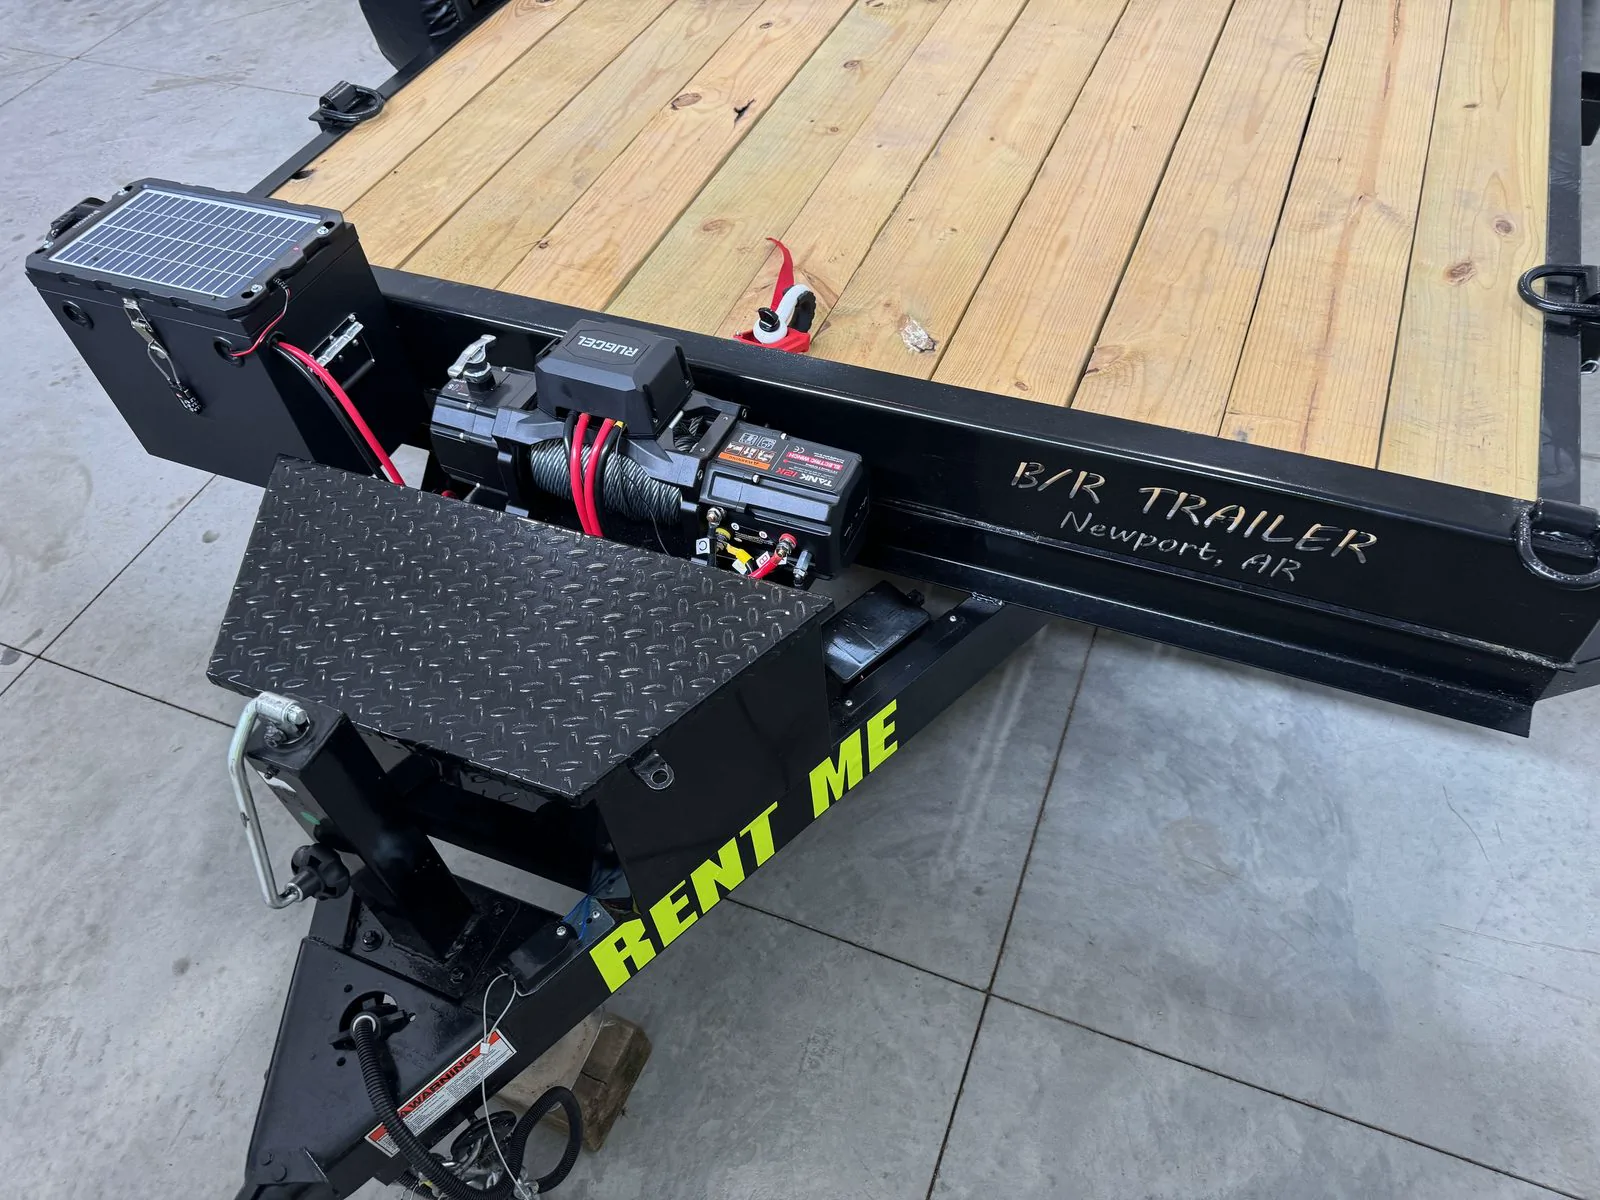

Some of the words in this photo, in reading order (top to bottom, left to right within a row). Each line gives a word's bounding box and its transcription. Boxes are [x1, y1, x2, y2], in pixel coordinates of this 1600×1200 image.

[578, 335, 639, 357] RUGCEL
[788, 452, 810, 463] WINCH
[811, 458, 841, 469] ELECTRIC
[800, 473, 832, 487] TANK
[1011, 461, 1106, 504] B/R
[1139, 487, 1378, 564] TRAILER
[1060, 511, 1224, 568] Newport,
[1241, 554, 1301, 582] AR
[589, 801, 778, 994] RENT
[809, 698, 898, 819] ME
[408, 1053, 477, 1110] WARNING
